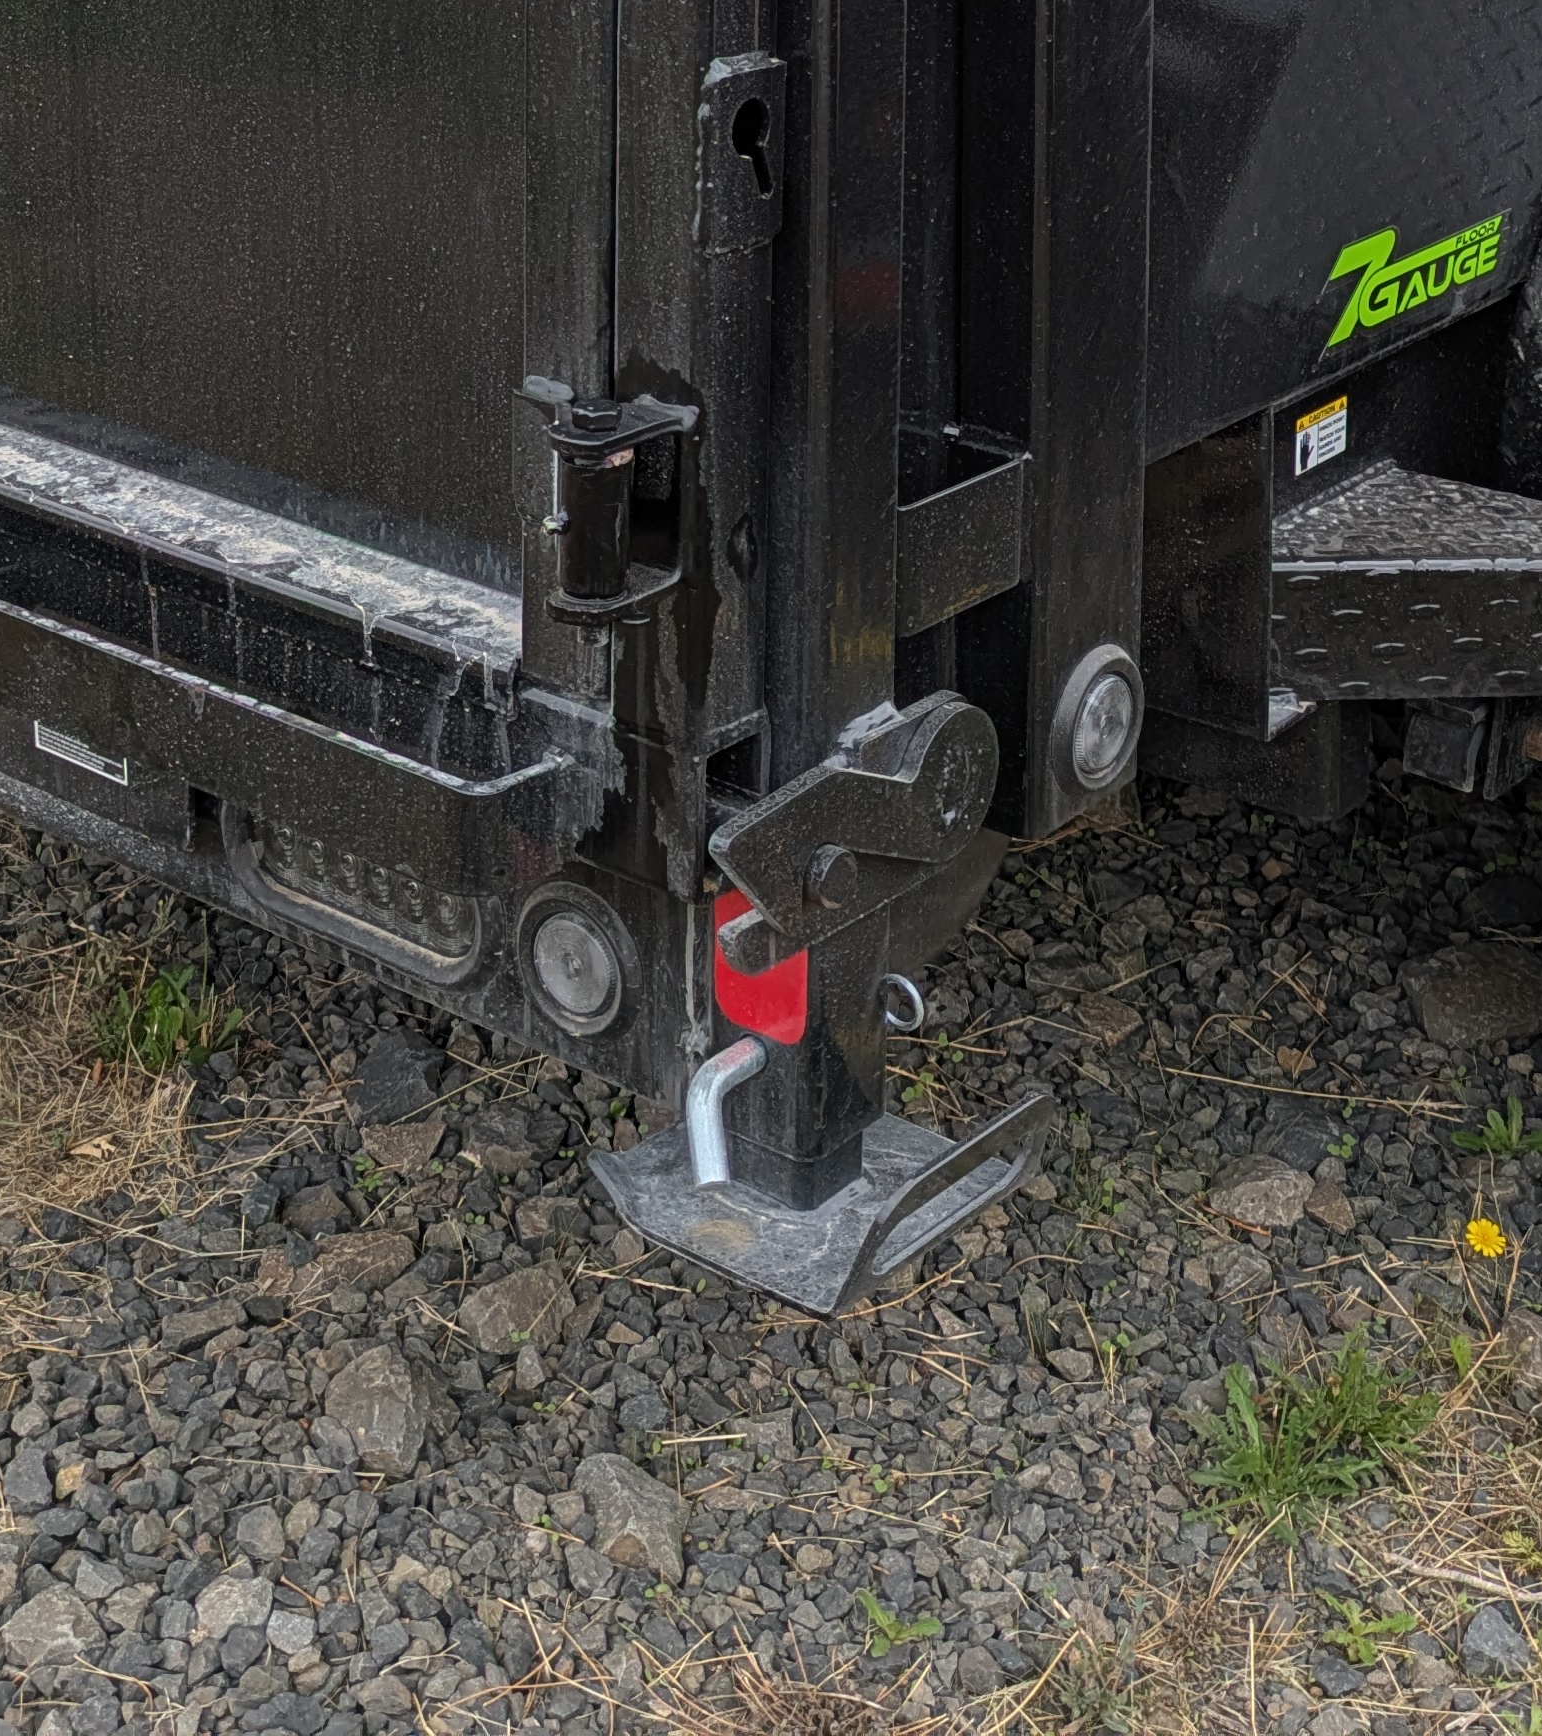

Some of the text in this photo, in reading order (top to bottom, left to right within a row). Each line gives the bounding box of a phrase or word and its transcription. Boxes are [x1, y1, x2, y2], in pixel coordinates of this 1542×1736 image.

[1454, 219, 1496, 248] FLOOR
[1327, 228, 1500, 348] 7 GAUGE
